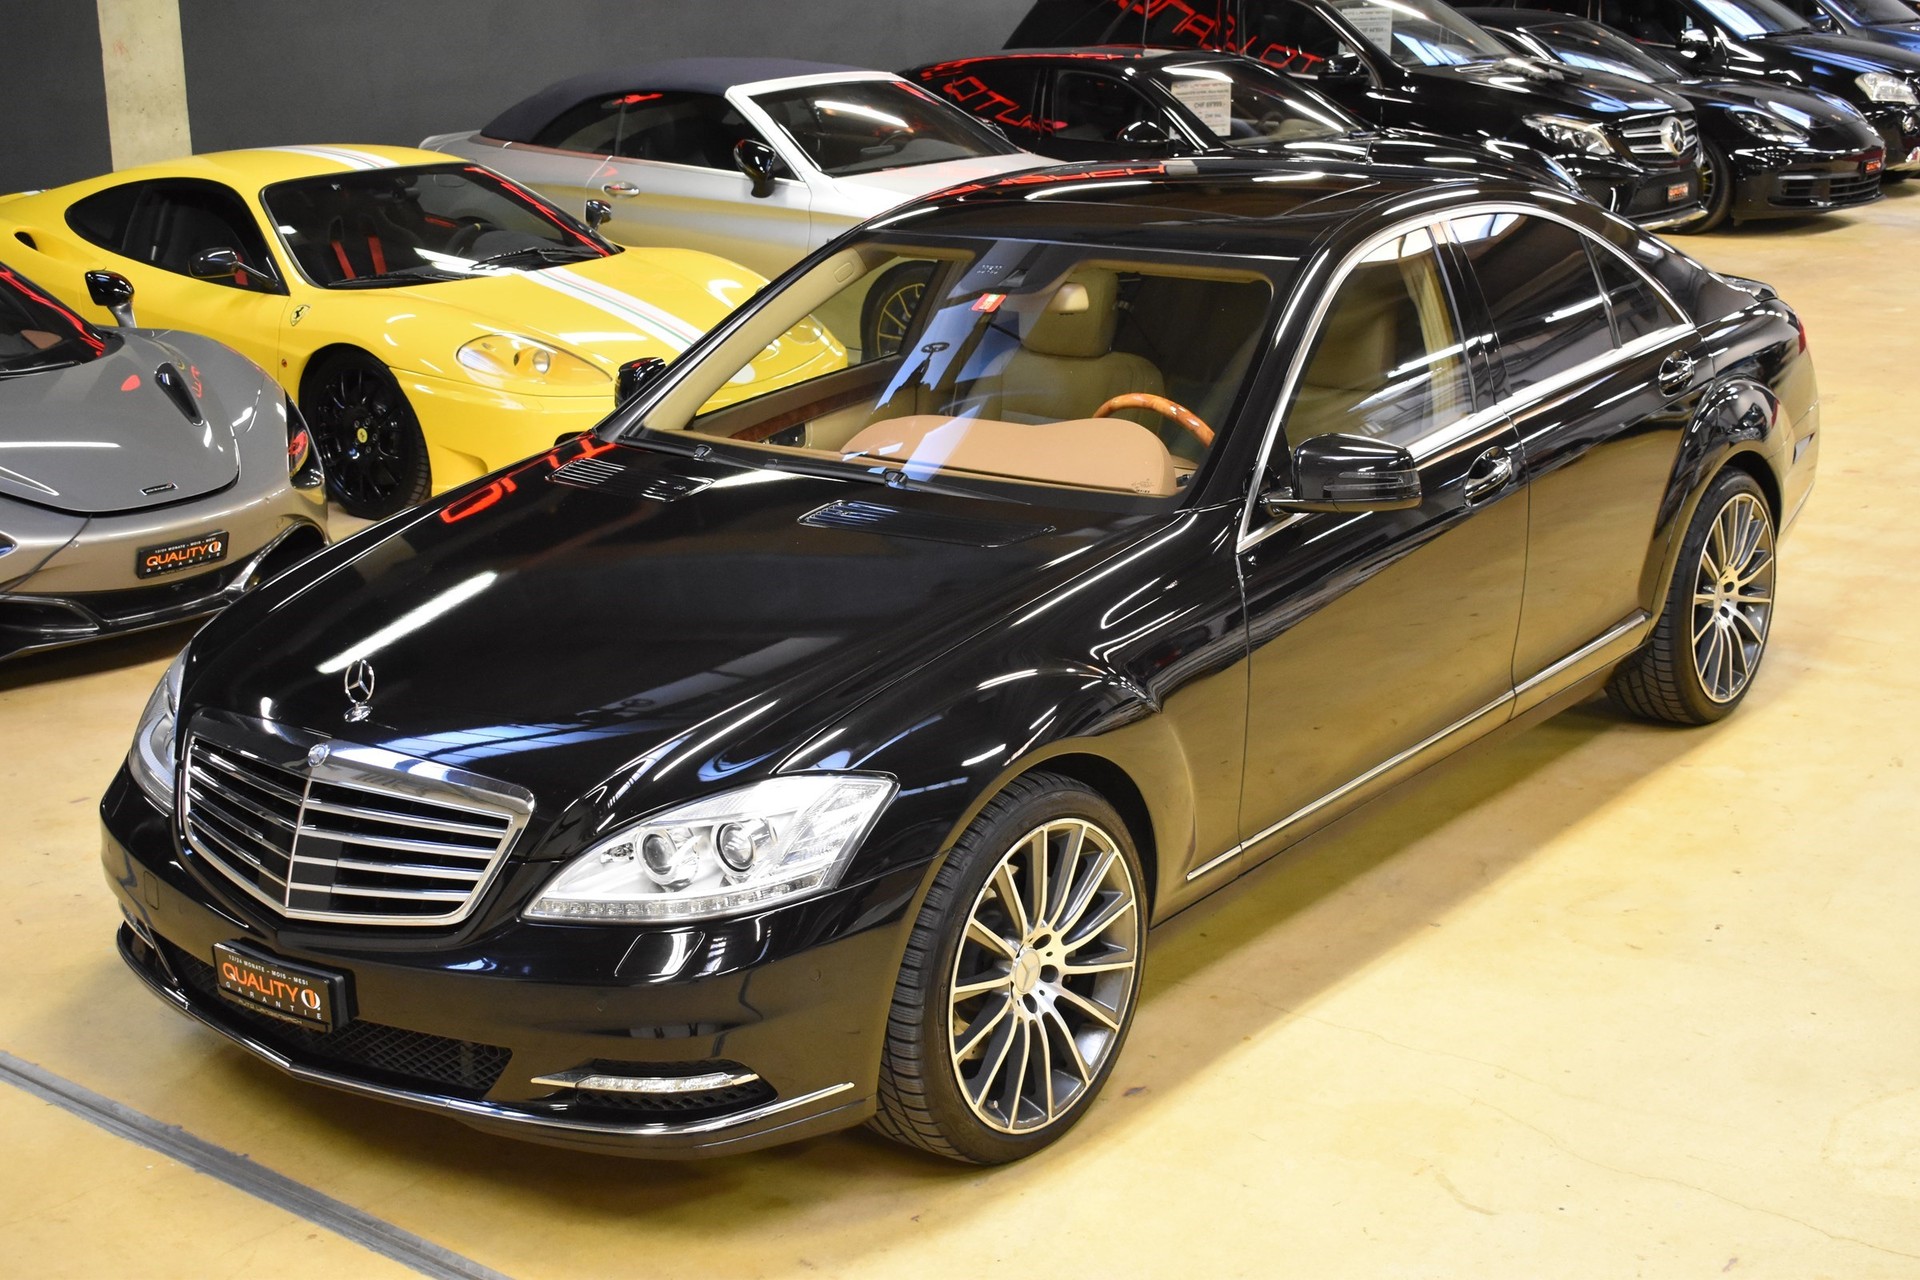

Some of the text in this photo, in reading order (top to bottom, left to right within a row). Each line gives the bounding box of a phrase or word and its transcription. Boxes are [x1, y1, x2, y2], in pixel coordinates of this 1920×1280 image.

[146, 544, 208, 567] QUALITY
[222, 962, 298, 1003] QUALITY
[225, 981, 322, 1020] GARANTIE
